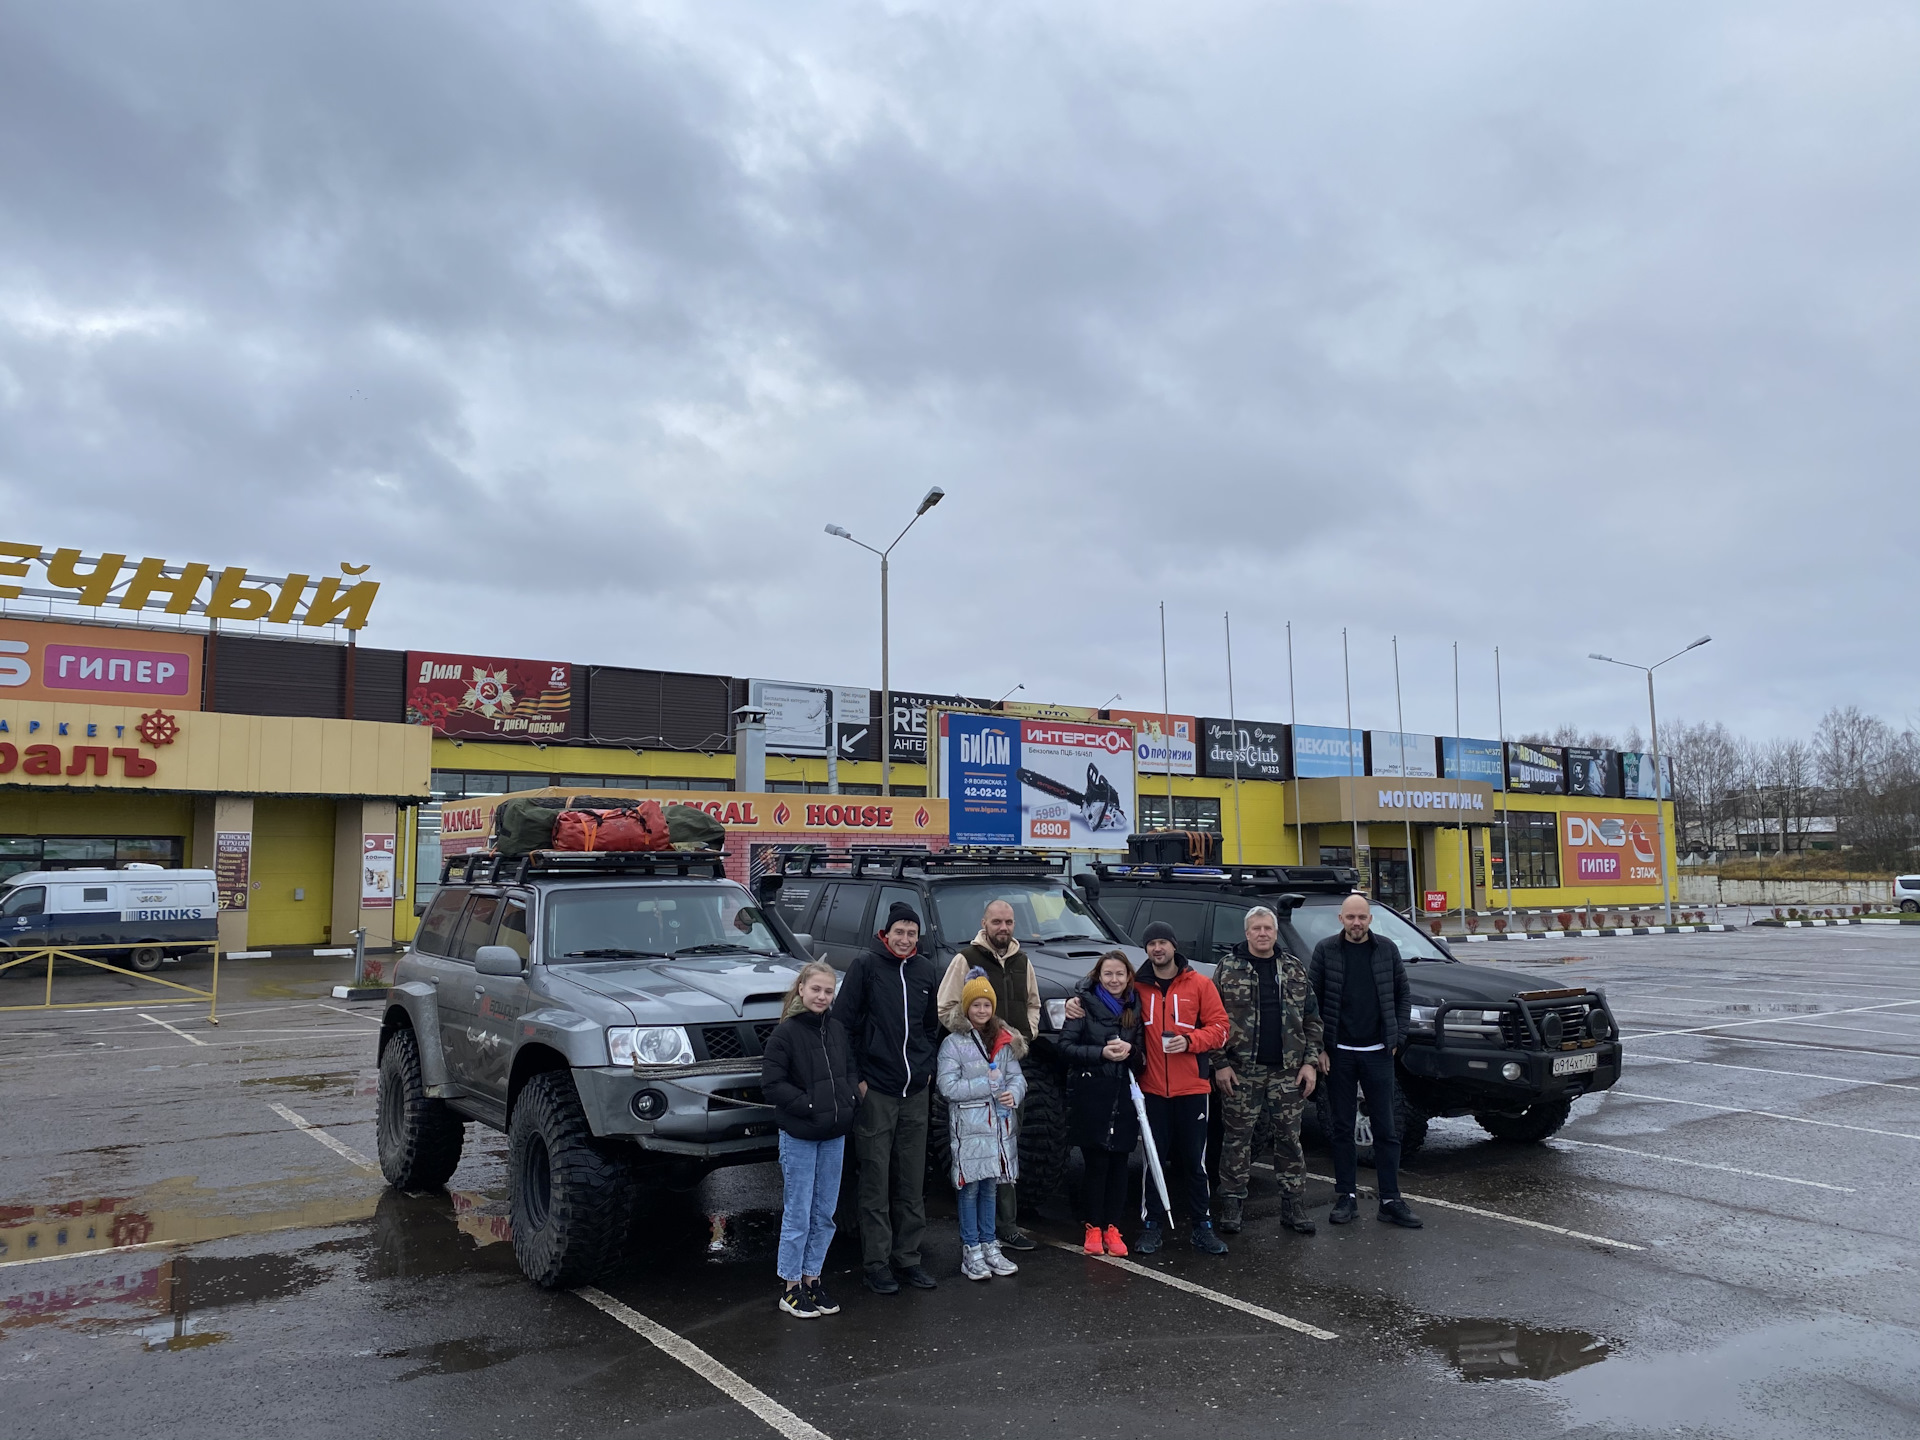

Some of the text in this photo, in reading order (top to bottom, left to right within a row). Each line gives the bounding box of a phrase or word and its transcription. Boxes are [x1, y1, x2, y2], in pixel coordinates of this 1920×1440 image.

[59, 655, 175, 684] ГИПЕР
[419, 661, 463, 683] 9 МАЯ
[551, 667, 565, 681] 75
[494, 719, 565, 734] С ДНЕМ ПОБЕДЫ!
[960, 728, 1011, 767] БИГАМ
[1027, 729, 1131, 752] ИНТЕРСКОЛ
[1296, 737, 1362, 758] ДЕКАТЛОН
[1028, 747, 1059, 756] Бензопила
[1445, 758, 1502, 775] ДЖНСЛАНДИЯ
[1520, 765, 1557, 783] АВТОСВЕТ
[964, 787, 1007, 798] 42-02-02
[806, 804, 894, 827] HOUSE
[964, 806, 1007, 814] www.bigam.ru
[1035, 806, 1061, 820] 5980
[442, 808, 483, 833] MANGAL
[1033, 823, 1061, 835] 4890
[1581, 858, 1617, 874] ГИПЕР
[1630, 867, 1657, 879] 2 ЭТАЖ
[139, 909, 202, 920] BRINKS
